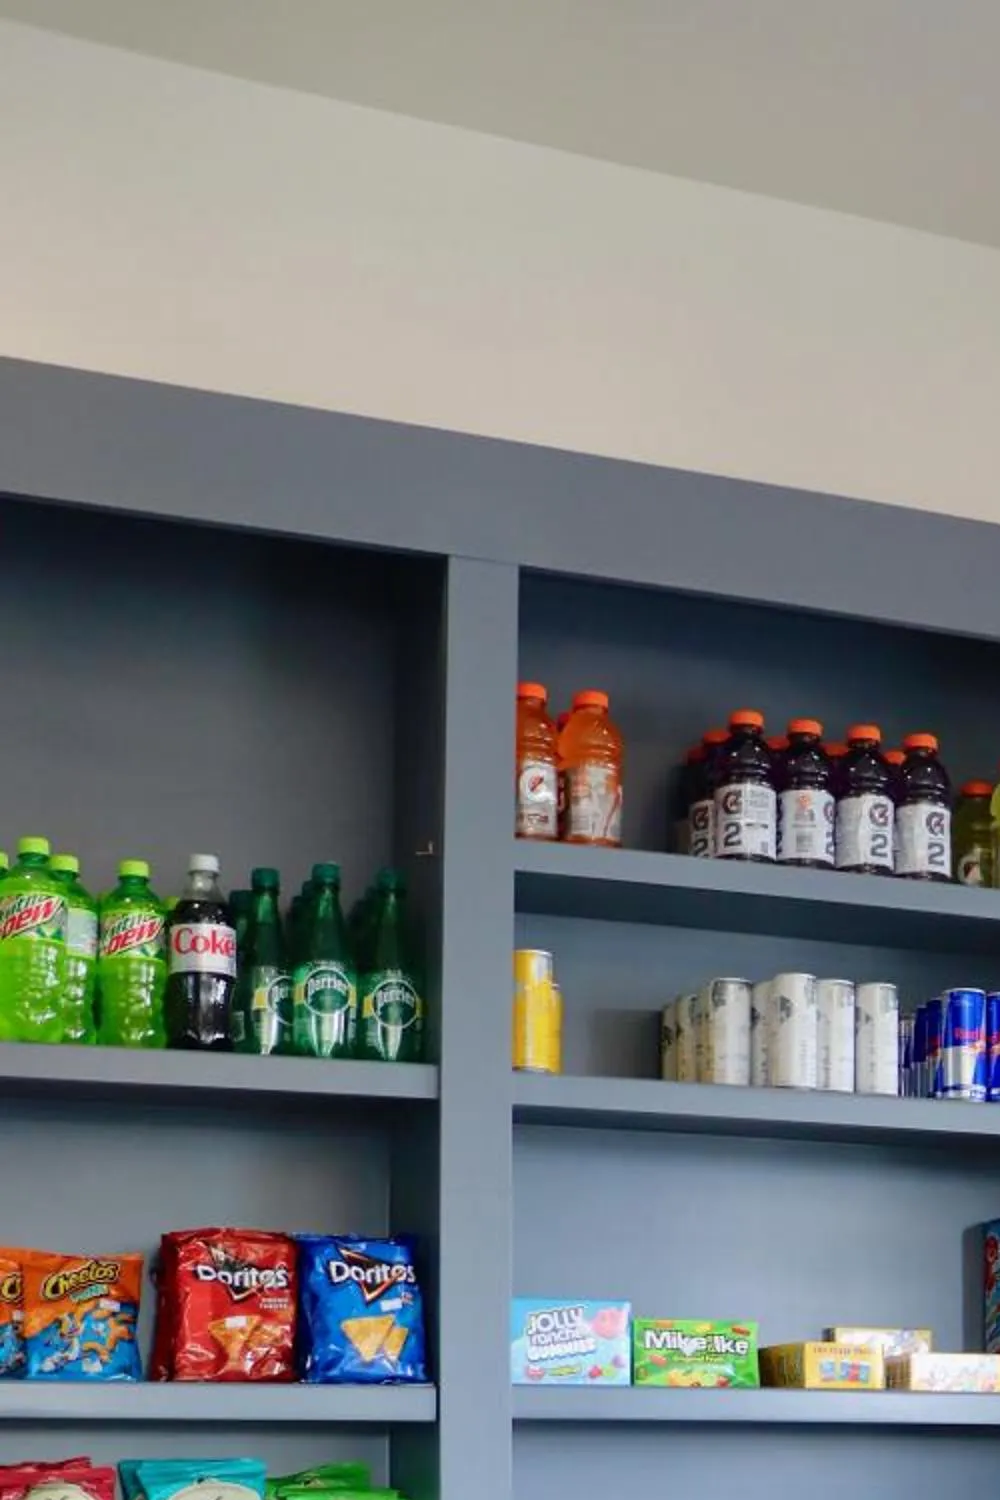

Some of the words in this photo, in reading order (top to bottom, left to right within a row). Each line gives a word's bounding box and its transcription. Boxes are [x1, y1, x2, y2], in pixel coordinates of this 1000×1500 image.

[724, 822, 742, 847] 2
[871, 833, 888, 858] 2
[928, 842, 945, 866] 2
[174, 926, 235, 958] Coke
[42, 1261, 120, 1300] Cheetos
[197, 1263, 289, 1289] Doritos
[328, 1261, 416, 1284] Doritos
[713, 1336, 749, 1355] Ike
